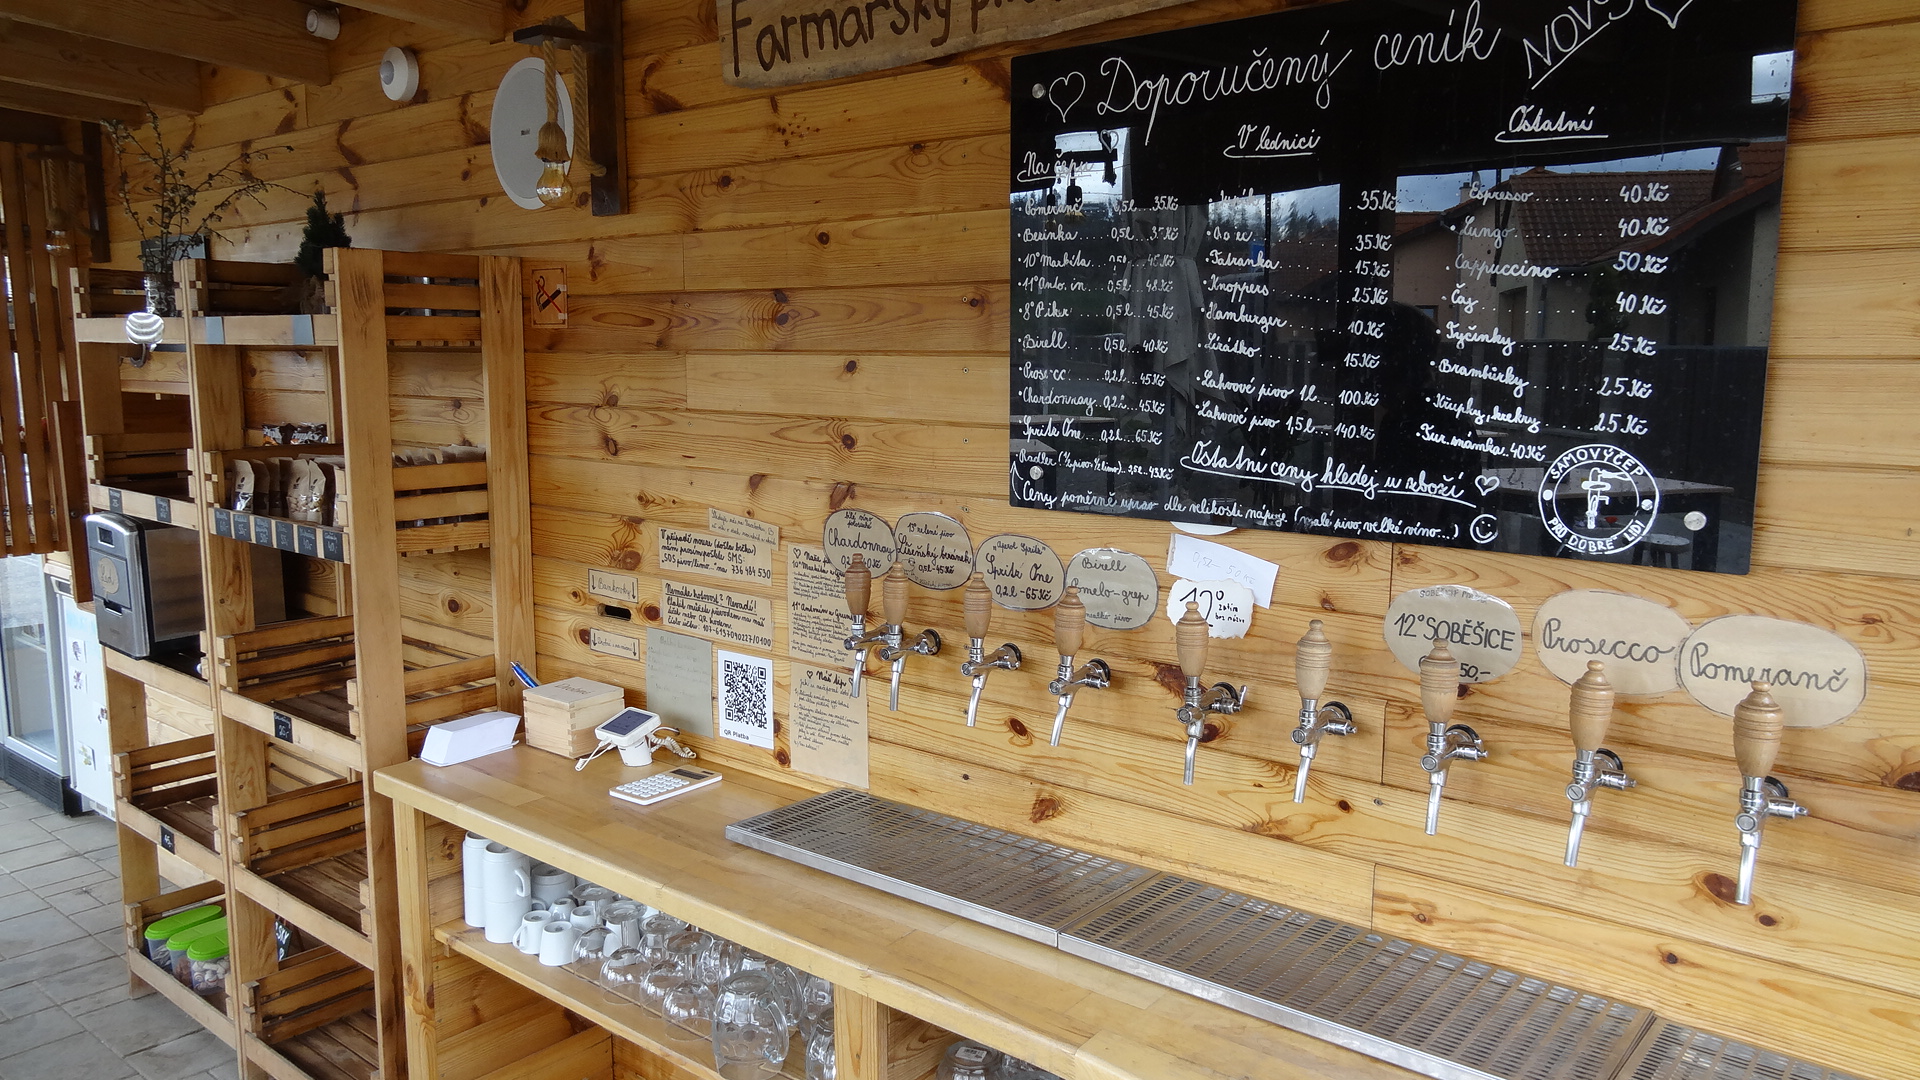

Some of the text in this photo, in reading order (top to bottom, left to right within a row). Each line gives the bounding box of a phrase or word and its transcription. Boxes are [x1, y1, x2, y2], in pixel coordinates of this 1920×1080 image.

[1097, 0, 1501, 146] Doporučený ceník
[1509, 105, 1595, 134] Ostatní
[1237, 125, 1256, 147] V
[1024, 151, 1050, 177] Na
[1025, 198, 1083, 215] Pomeranč
[1469, 181, 1534, 206] Espresso
[1459, 215, 1516, 249] Lungo
[1207, 249, 1280, 270] Tatranka
[1455, 253, 1559, 280] Cappuccino
[1208, 274, 1269, 303] Knoppers
[1206, 301, 1288, 333] Hamburger
[1446, 321, 1516, 356] Tyčinky
[1191, 440, 1267, 474] Ostatní
[1270, 461, 1318, 492] ceny
[1322, 456, 1380, 500] hledej
[1550, 447, 1644, 479] SAMOVÝČEP
[1023, 481, 1057, 509] Ceny
[1164, 496, 1187, 512] dle
[828, 527, 895, 561] Chardonnay
[731, 564, 744, 575] 736
[758, 567, 771, 579] 530
[1082, 557, 1127, 572] Birell
[1542, 617, 1676, 664] Prosecco
[1690, 641, 1849, 693] Pomeranč
[732, 731, 750, 741] Platba
